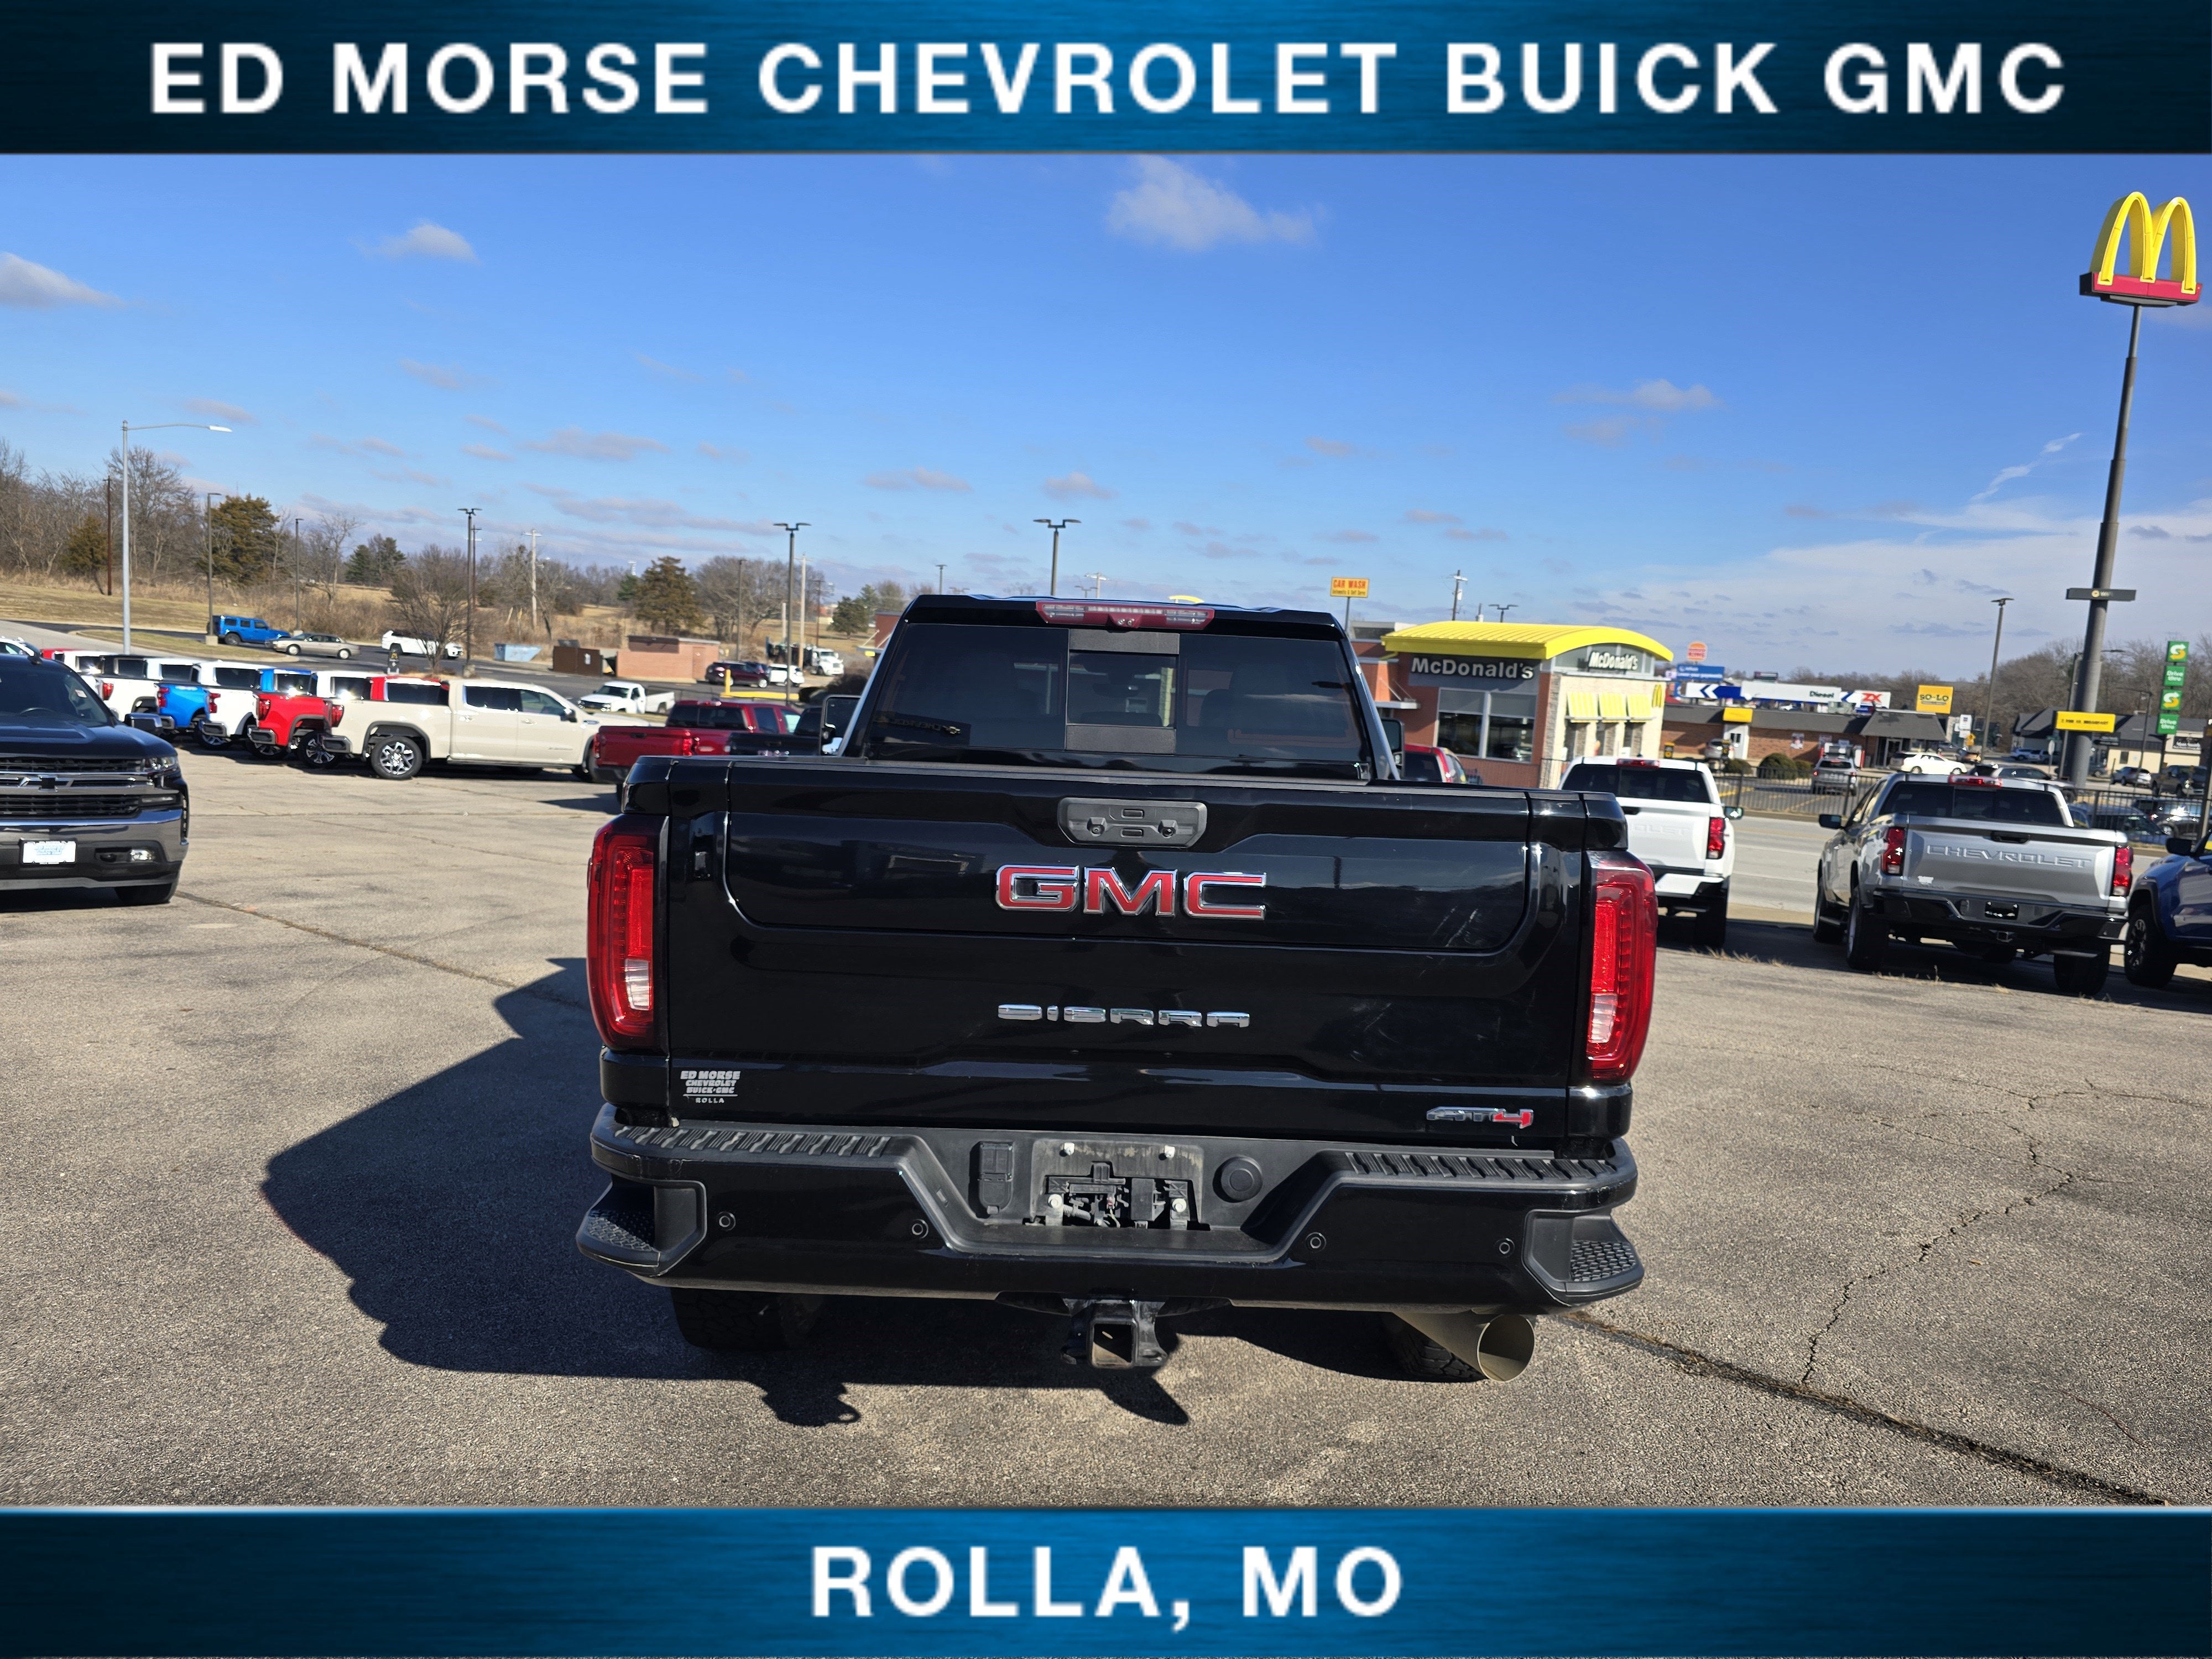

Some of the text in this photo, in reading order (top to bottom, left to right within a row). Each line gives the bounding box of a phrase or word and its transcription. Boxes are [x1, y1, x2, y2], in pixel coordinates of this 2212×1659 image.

[1333, 580, 1366, 589] CAR WASH
[1411, 657, 1534, 680] McDonald's
[1588, 651, 1638, 671] McDonald's
[1927, 844, 2092, 868] CHEVROLET
[995, 864, 1267, 921] GMC
[997, 1004, 1250, 1028] SIERRA
[680, 1070, 741, 1080] ED MORSE
[1426, 1106, 1534, 1129] AT4
